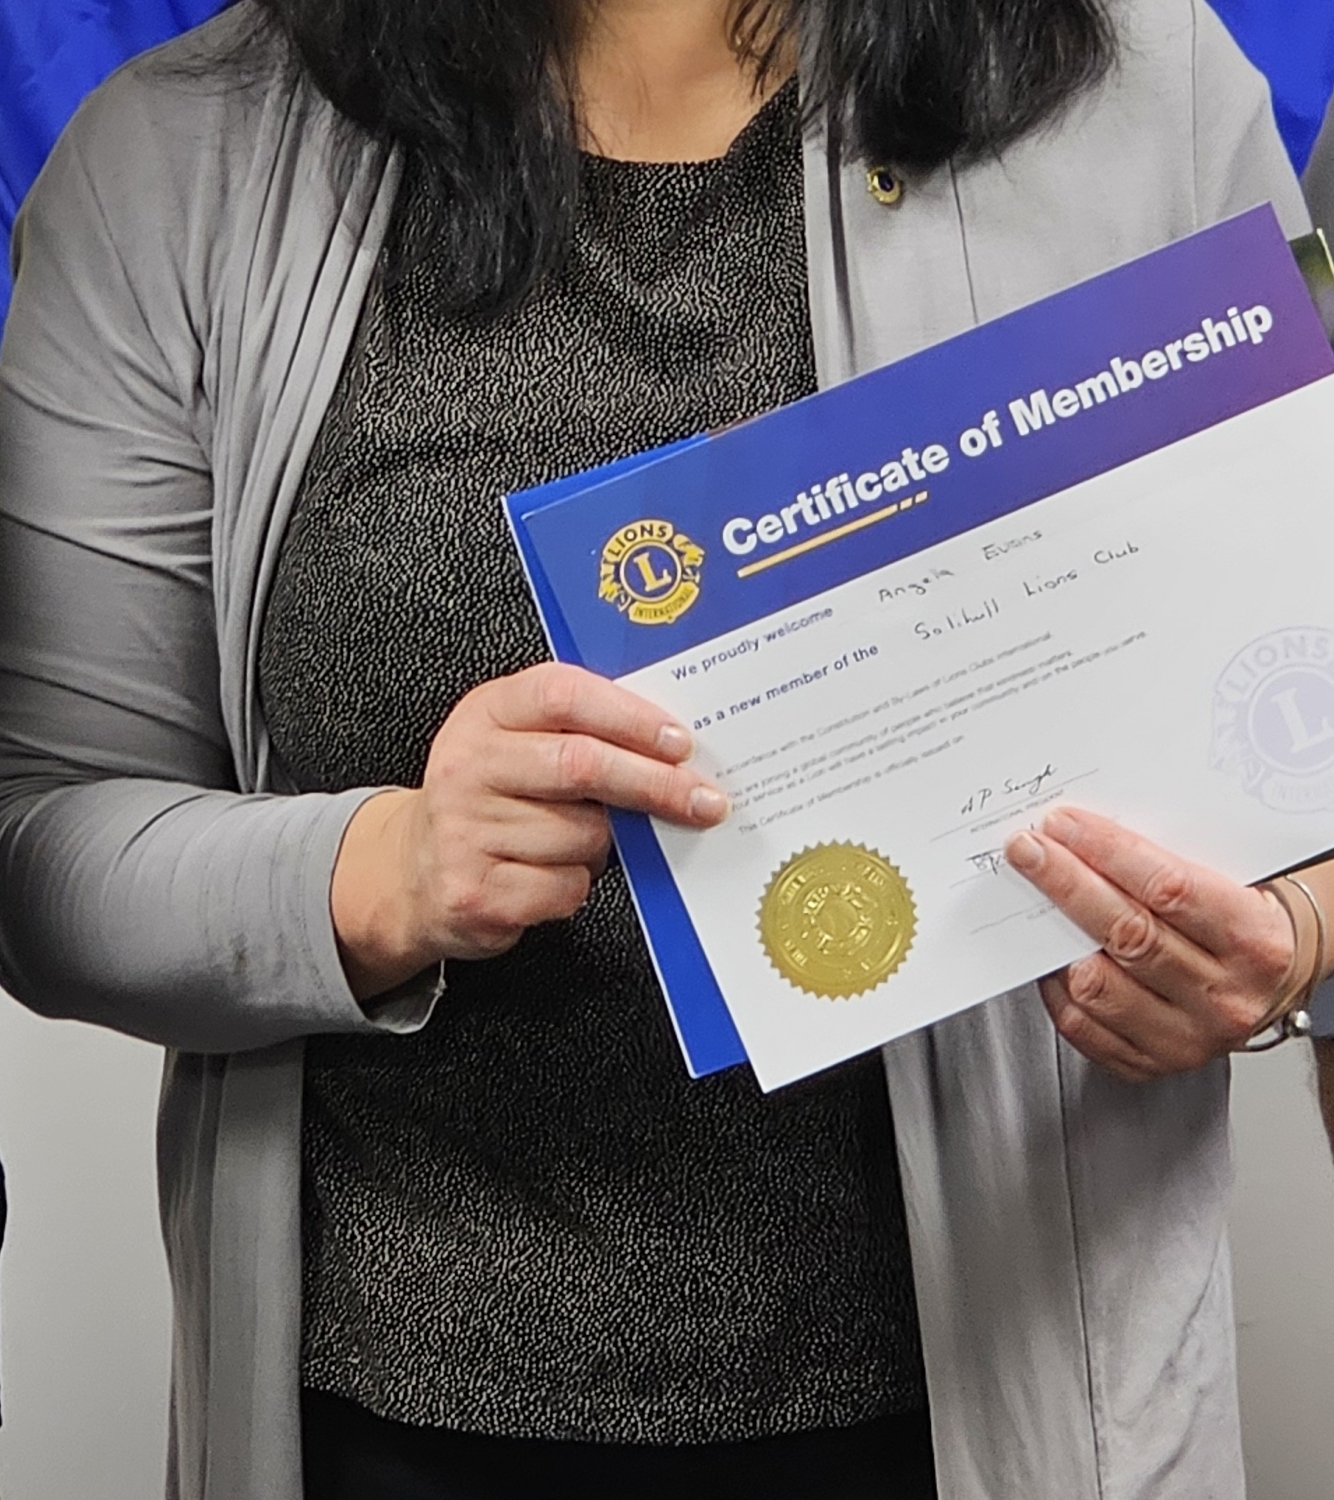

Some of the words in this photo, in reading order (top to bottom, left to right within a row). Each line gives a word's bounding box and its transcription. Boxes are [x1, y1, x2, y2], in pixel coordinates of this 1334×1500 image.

[722, 444, 950, 556] Certificate
[959, 409, 1003, 458] of
[1008, 304, 1274, 437] Membership
[607, 523, 668, 558] LIONS
[981, 530, 1043, 561] Evans
[1022, 569, 1078, 597] Lions
[1093, 541, 1139, 565] Club
[633, 552, 672, 592] L
[671, 665, 698, 681] We
[701, 638, 759, 673] proudly
[763, 607, 833, 643] welcome
[1226, 635, 1329, 696] LIONS
[693, 716, 712, 731] as
[715, 710, 726, 721] a
[729, 695, 761, 716] new
[765, 665, 829, 701] member
[833, 653, 849, 671] of
[852, 645, 879, 663] the
